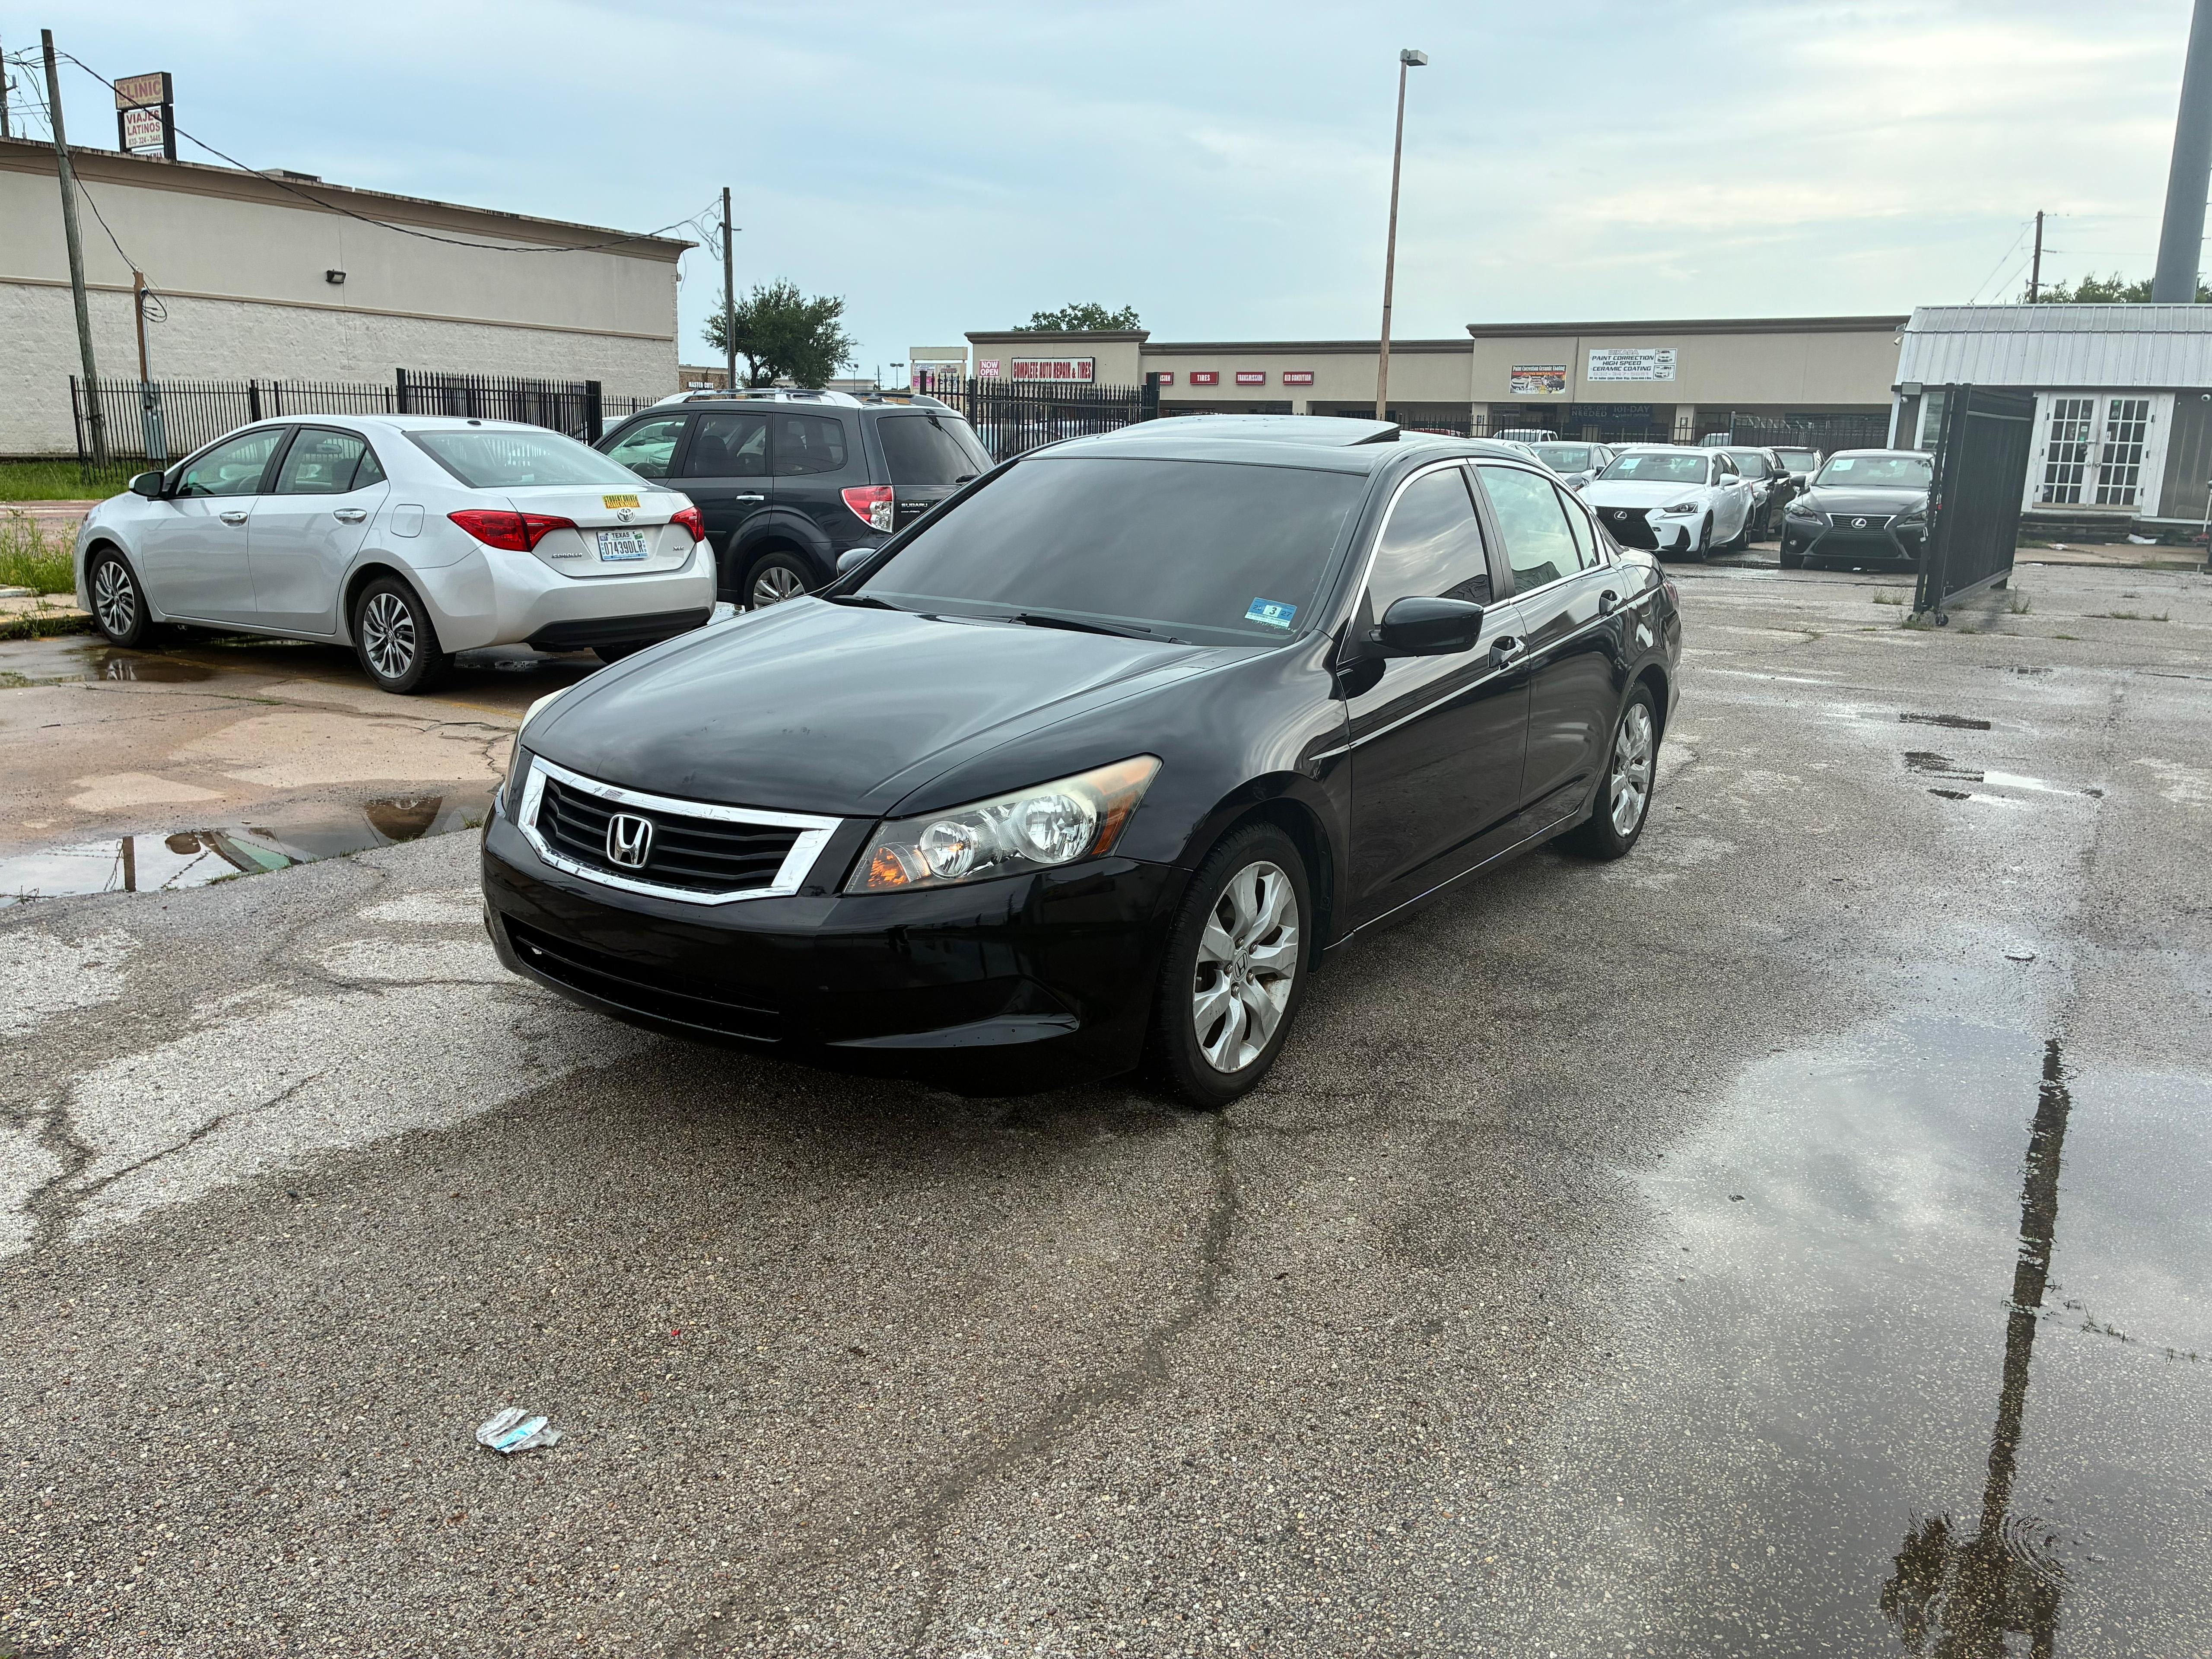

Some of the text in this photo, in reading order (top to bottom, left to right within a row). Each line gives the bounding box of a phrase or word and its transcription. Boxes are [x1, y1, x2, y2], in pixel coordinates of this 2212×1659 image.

[118, 79, 162, 101] CLINIC
[127, 122, 160, 136] LATINOS
[1013, 362, 1091, 379] COMPLETE AUTO REPAIR & TIRES
[604, 540, 644, 555] 07439DLR
[1269, 607, 1278, 615] 3
